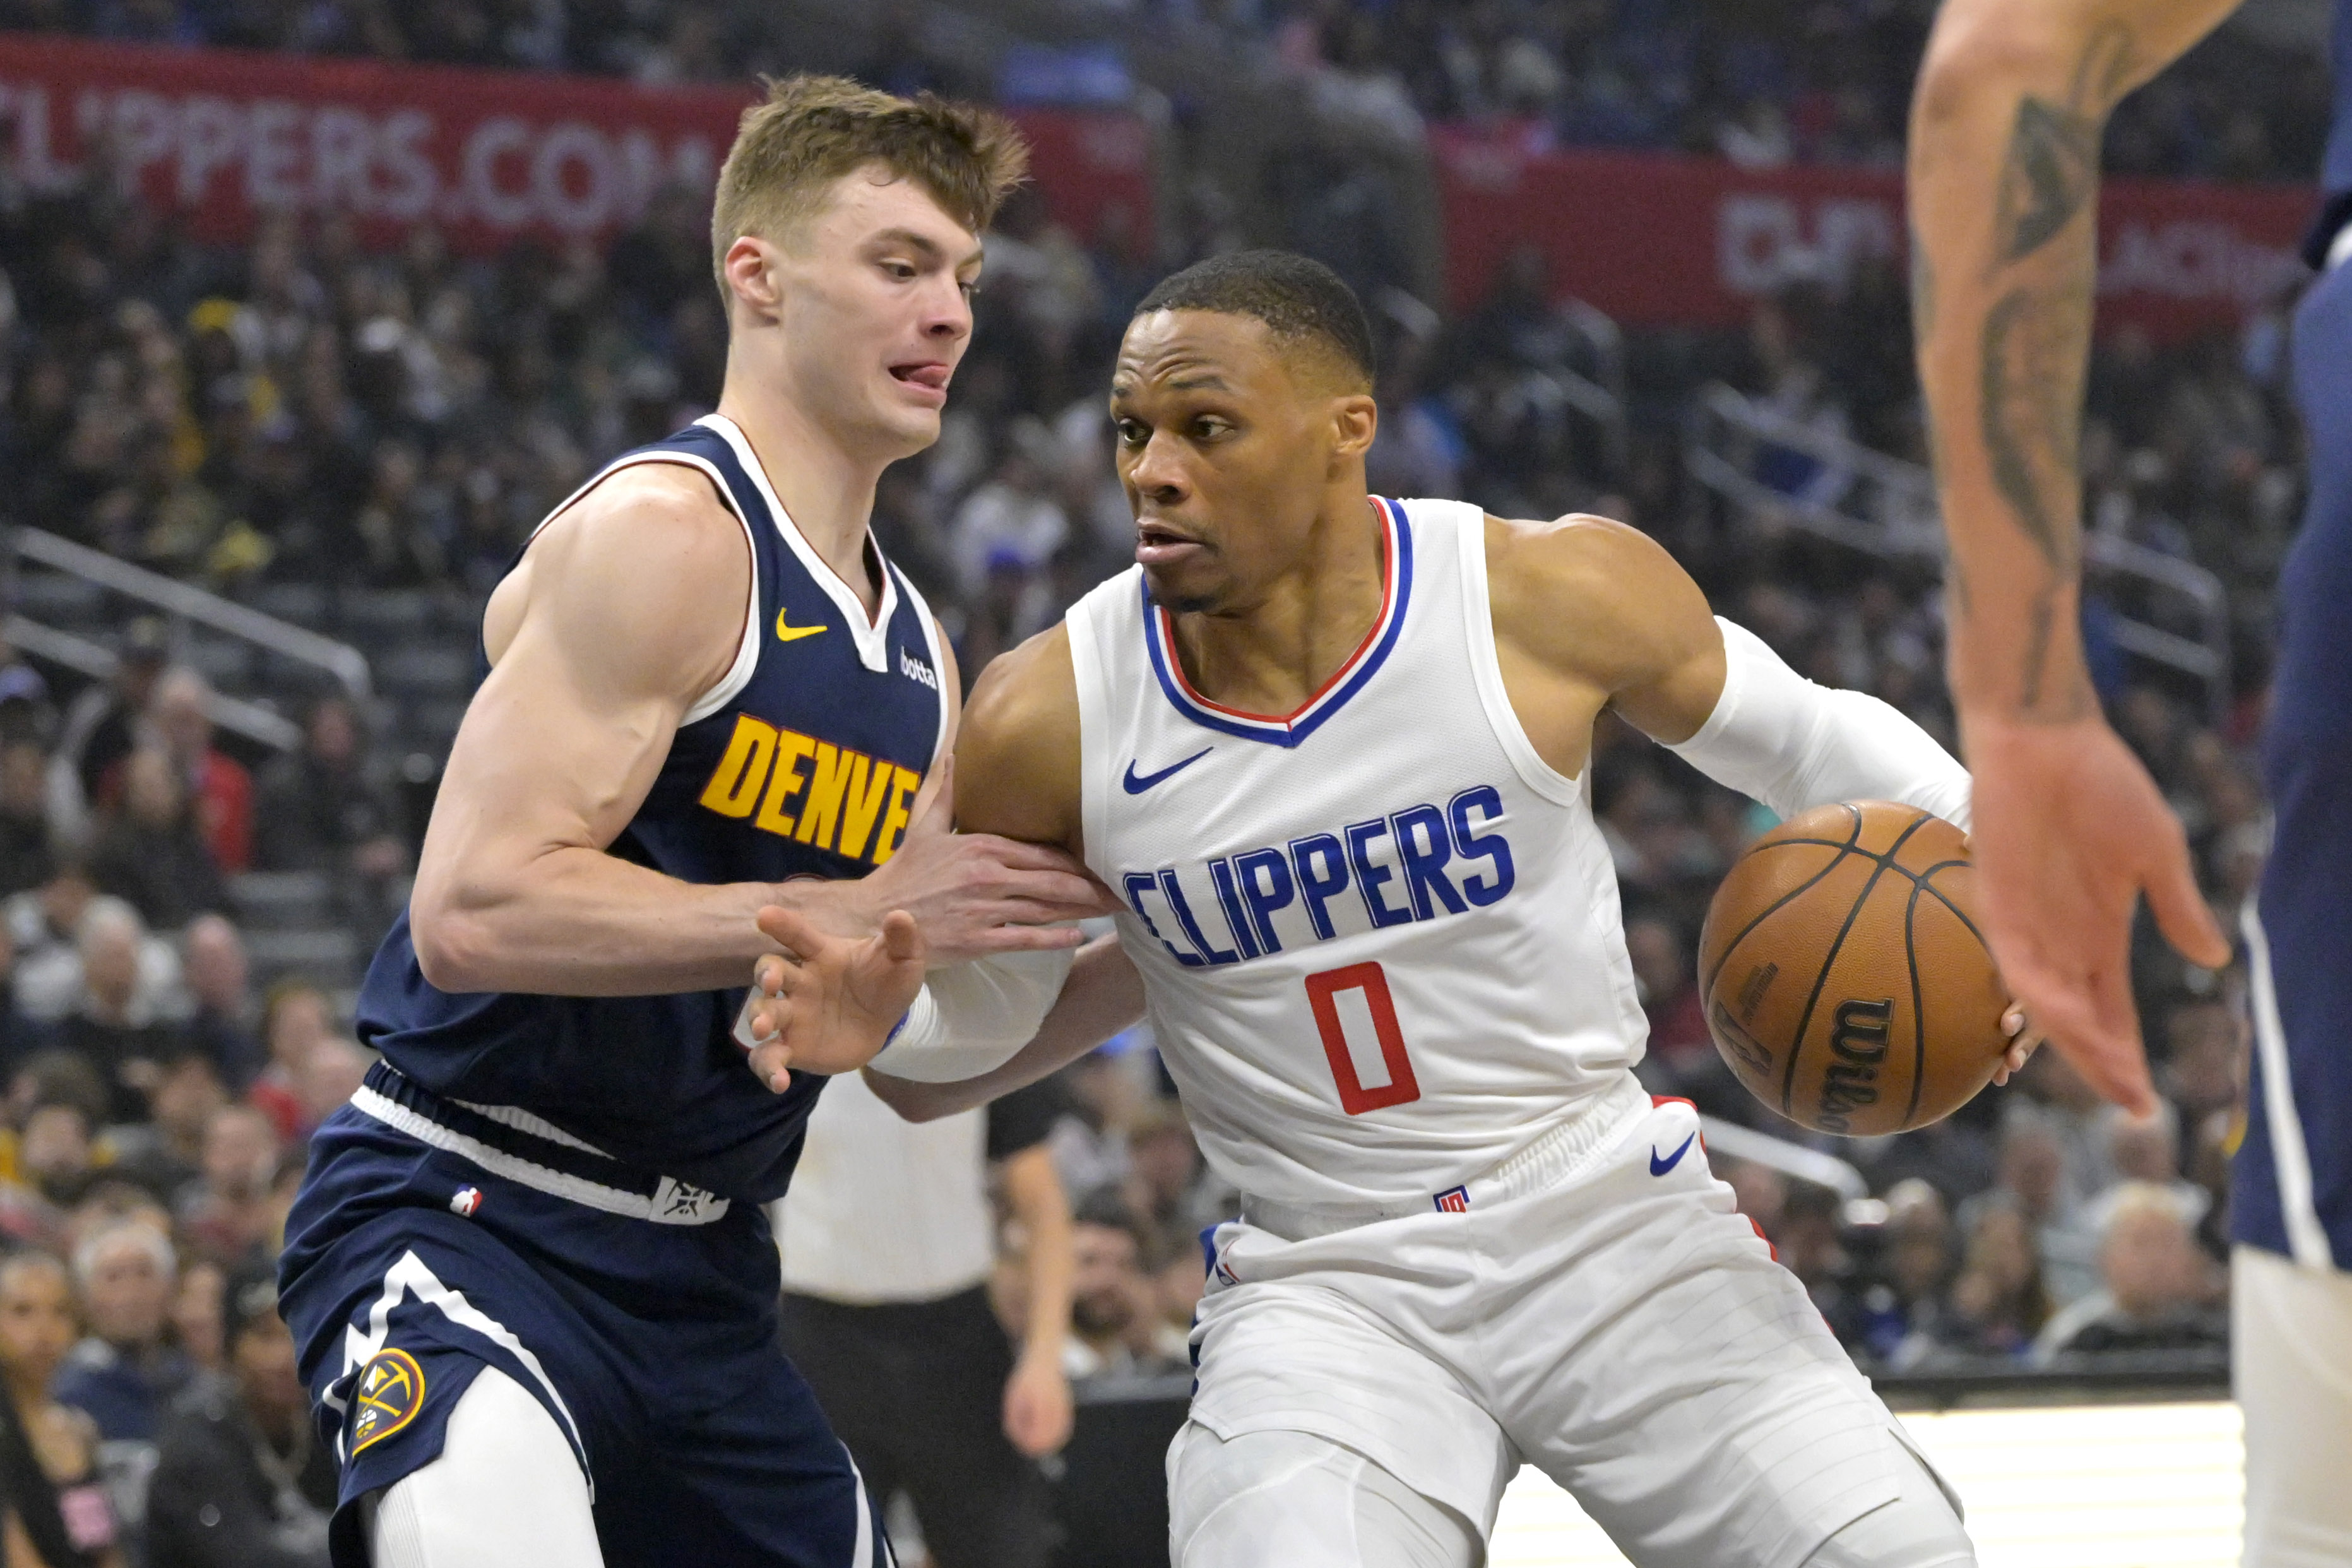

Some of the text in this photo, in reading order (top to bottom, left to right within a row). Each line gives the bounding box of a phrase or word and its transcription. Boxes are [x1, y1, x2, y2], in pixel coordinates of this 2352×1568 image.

[698, 711, 922, 865] DENVE
[1122, 785, 1516, 967] CLIPPERS
[1304, 960, 1422, 1116] 0
